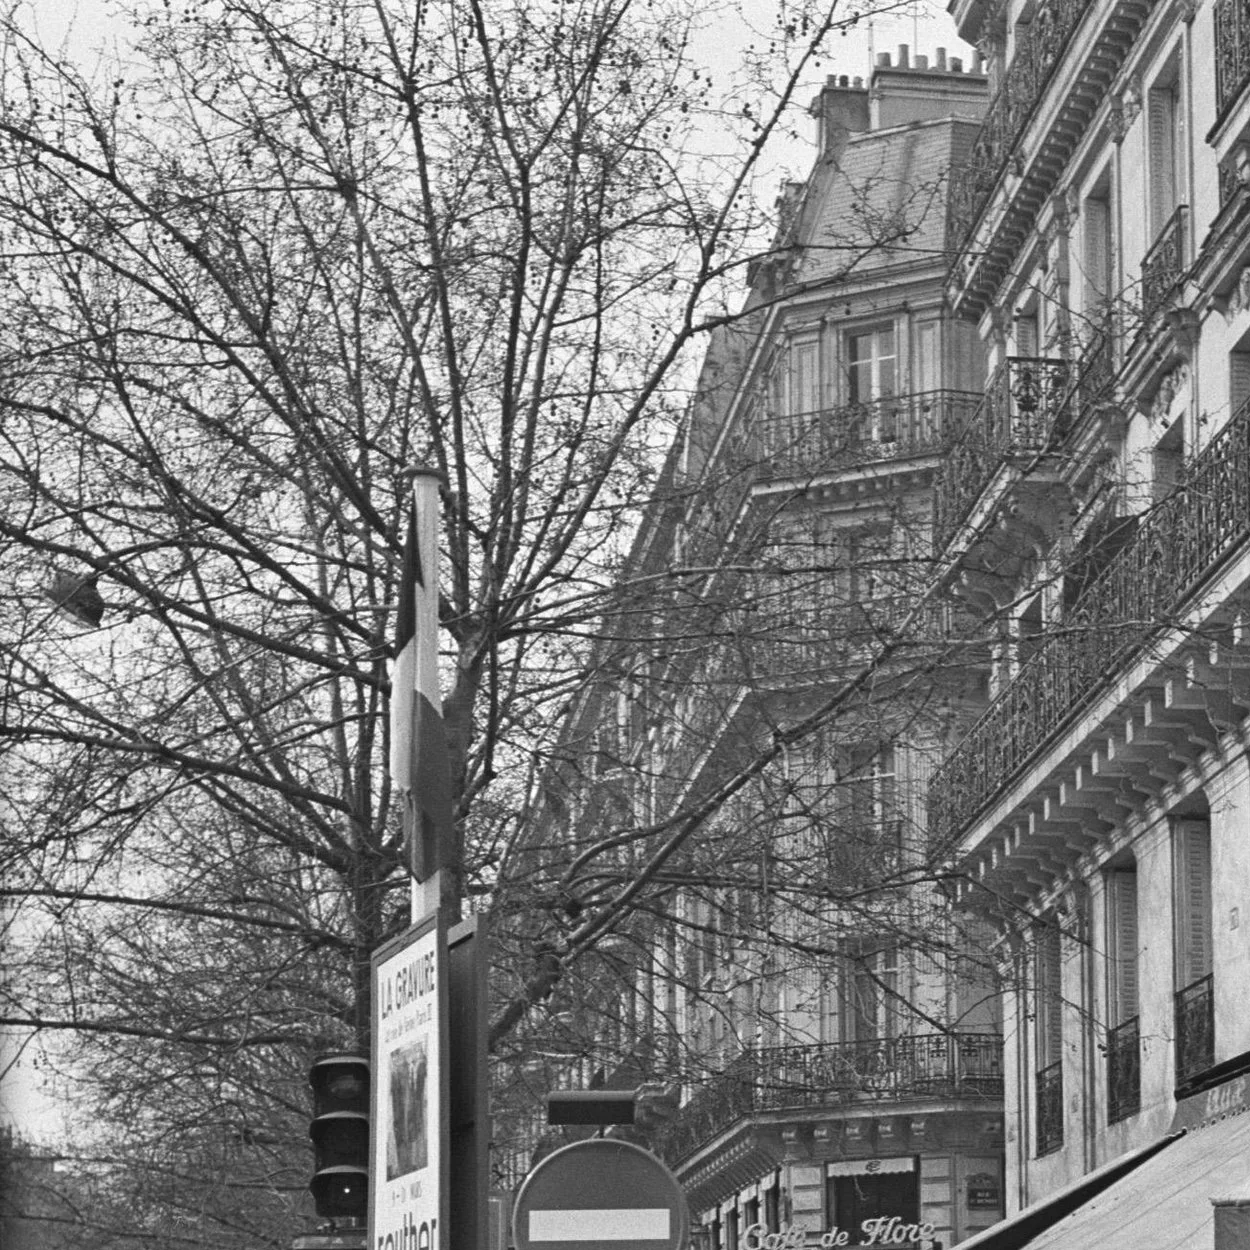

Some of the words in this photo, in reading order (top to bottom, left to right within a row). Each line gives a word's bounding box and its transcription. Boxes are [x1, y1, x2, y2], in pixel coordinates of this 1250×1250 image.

[395, 951, 435, 1010] GRAVURE
[821, 1225, 850, 1248] de
[860, 1215, 937, 1247] Flore
